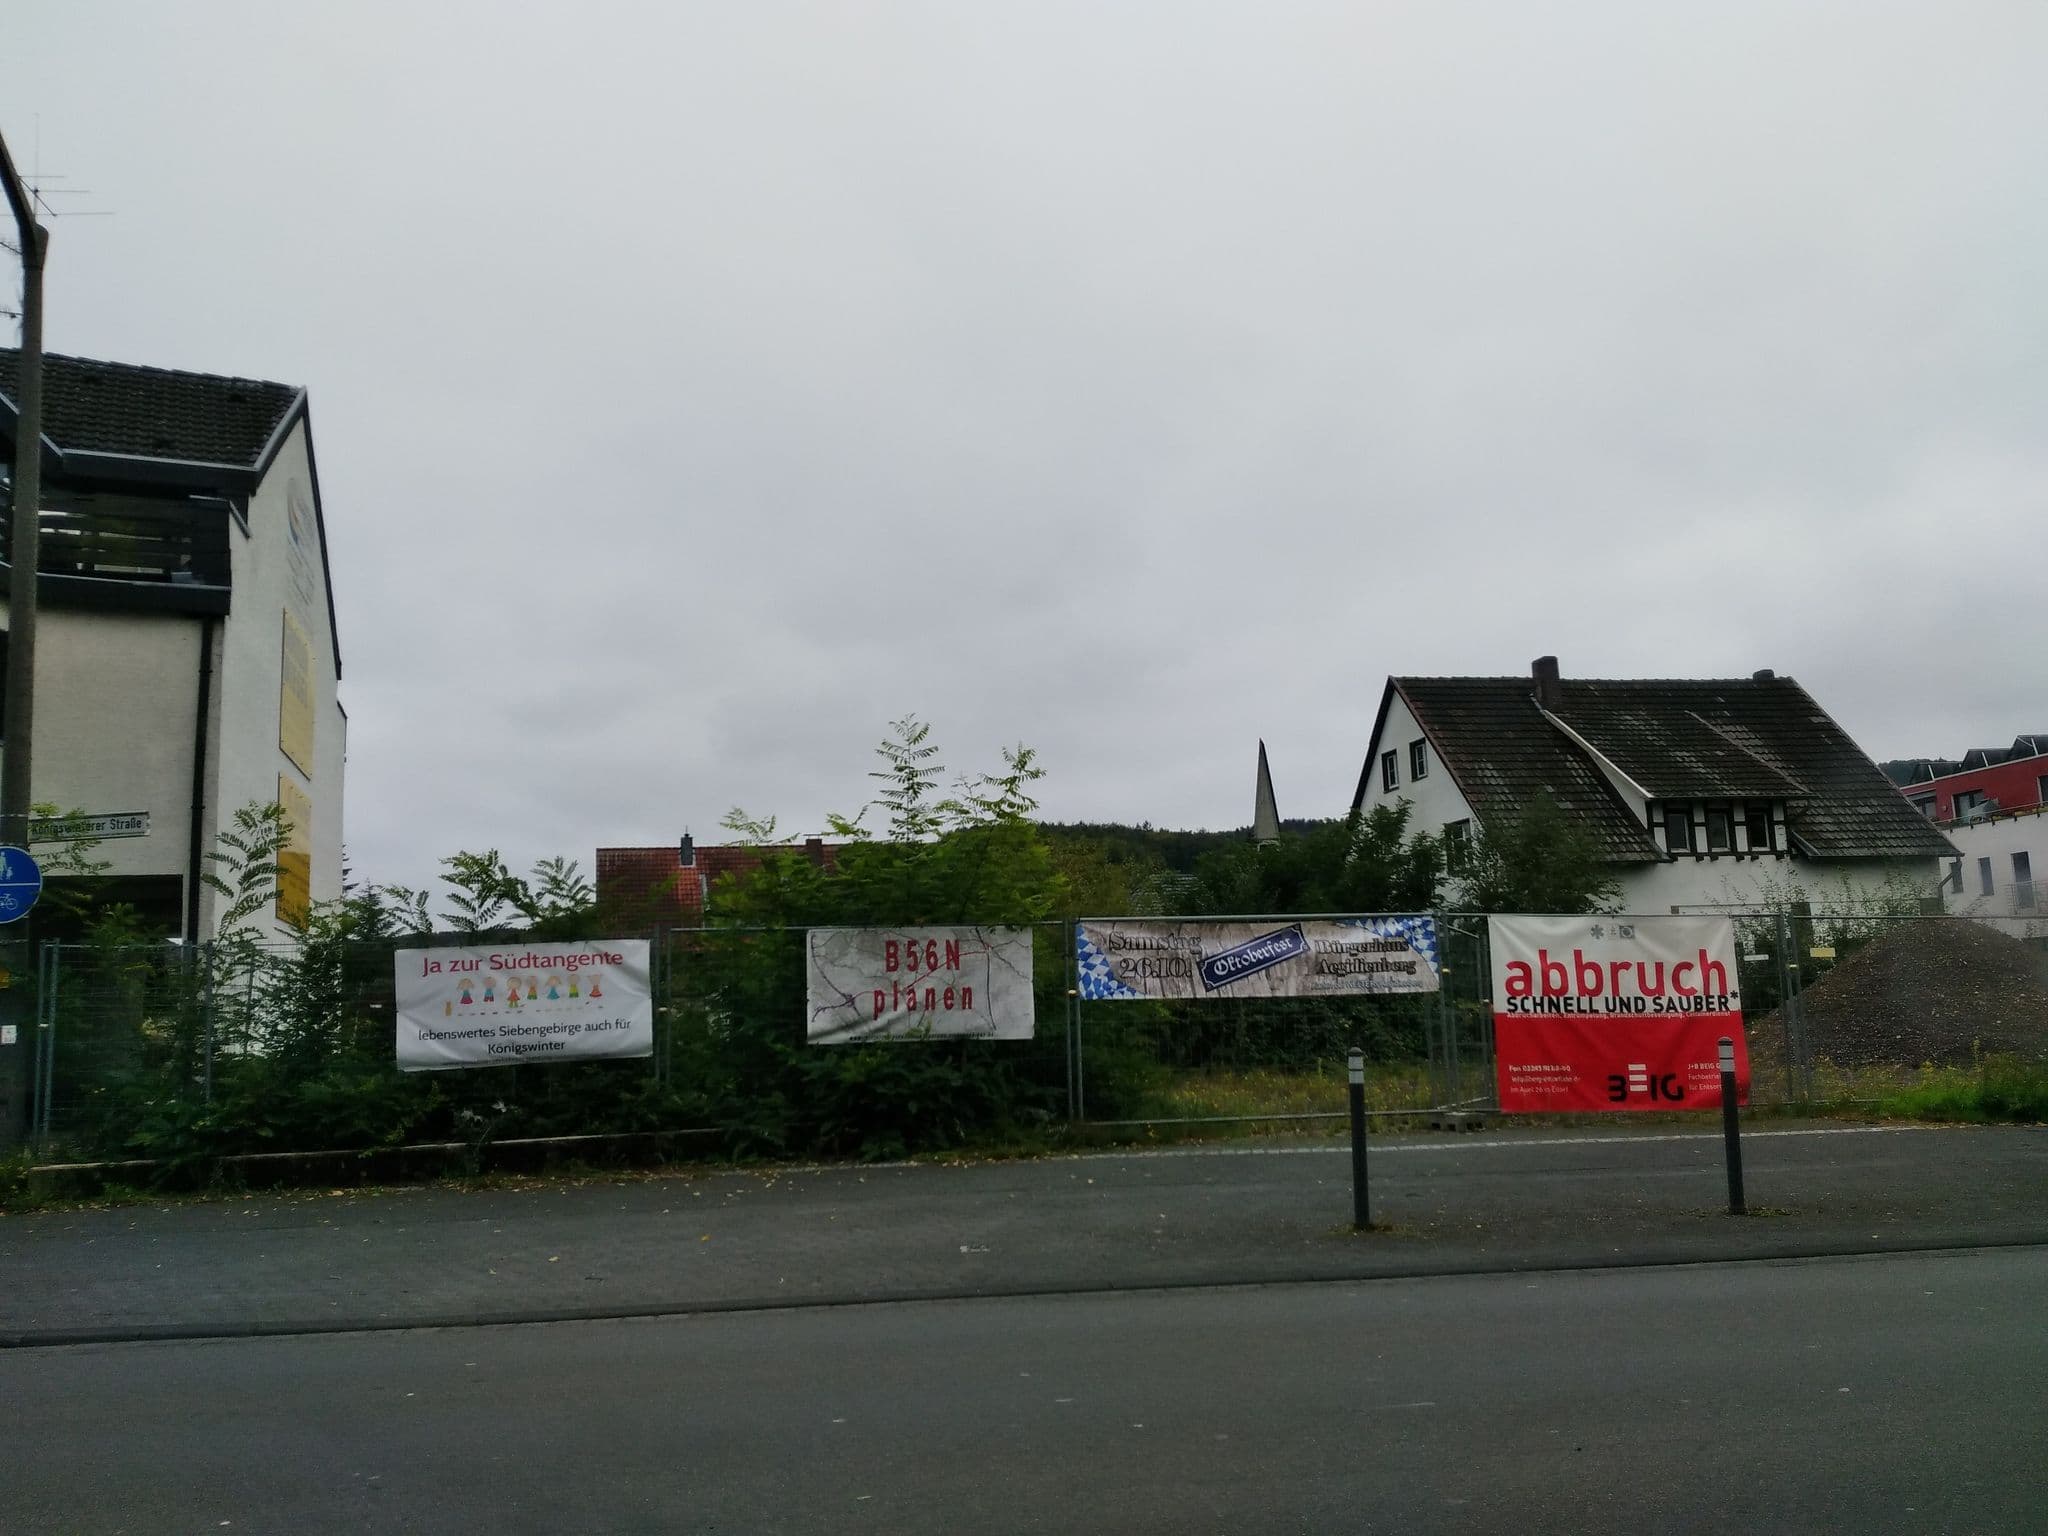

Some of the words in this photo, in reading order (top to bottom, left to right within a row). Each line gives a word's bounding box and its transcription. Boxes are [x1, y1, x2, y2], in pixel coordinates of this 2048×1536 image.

[110, 818, 142, 830] Straße
[1108, 931, 1203, 955] Samstag
[1314, 937, 1410, 957] Bürgerhaus
[422, 957, 442, 977] Ja
[448, 958, 483, 973] zur
[489, 951, 624, 972] Südtangente
[884, 938, 961, 973] B56N
[1213, 937, 1294, 977] Oktoberfest
[1316, 958, 1417, 977] Aegidienberg
[1504, 949, 1729, 997] abbruch
[872, 980, 974, 1021] planen
[1506, 996, 1600, 1014] SCHNELL
[1605, 996, 1646, 1013] UND
[418, 1027, 496, 1041] lebenswertes
[498, 1023, 582, 1037] Siebengebirge
[584, 1020, 612, 1032] auch
[614, 1018, 632, 1031] für
